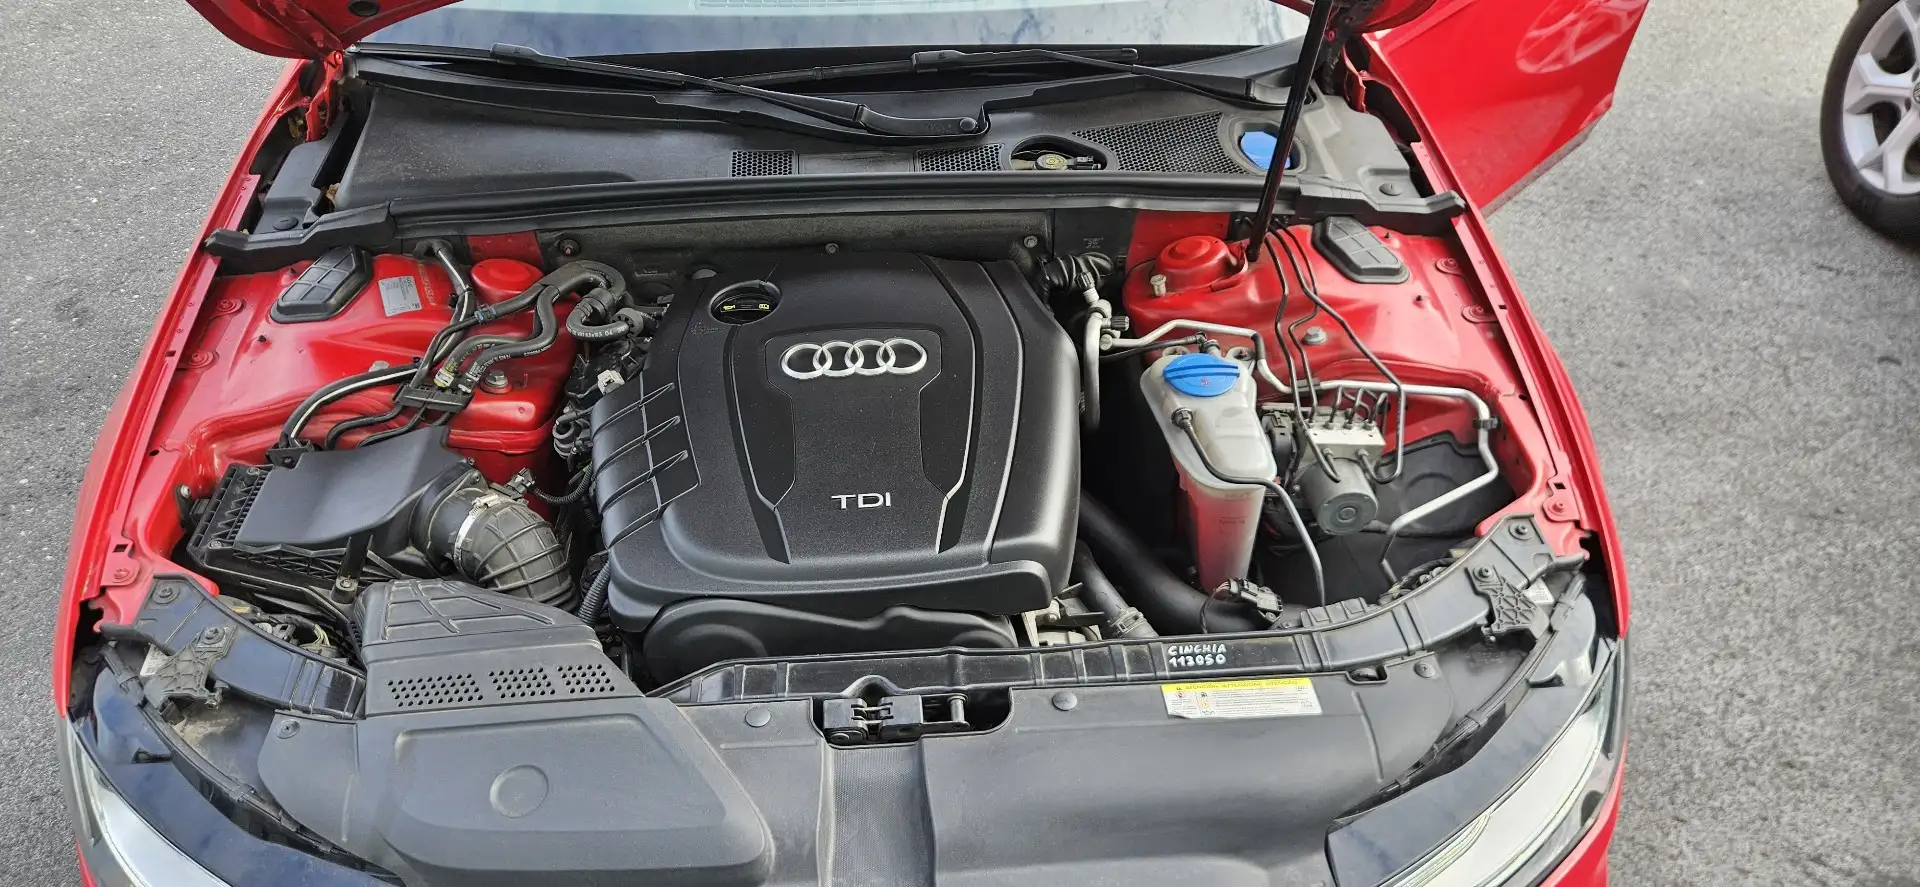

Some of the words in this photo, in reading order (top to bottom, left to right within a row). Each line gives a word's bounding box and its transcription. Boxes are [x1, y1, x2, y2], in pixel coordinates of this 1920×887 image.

[831, 492, 891, 509] TDI
[1168, 643, 1226, 656] CINGHIA
[1168, 653, 1226, 667] 113050
